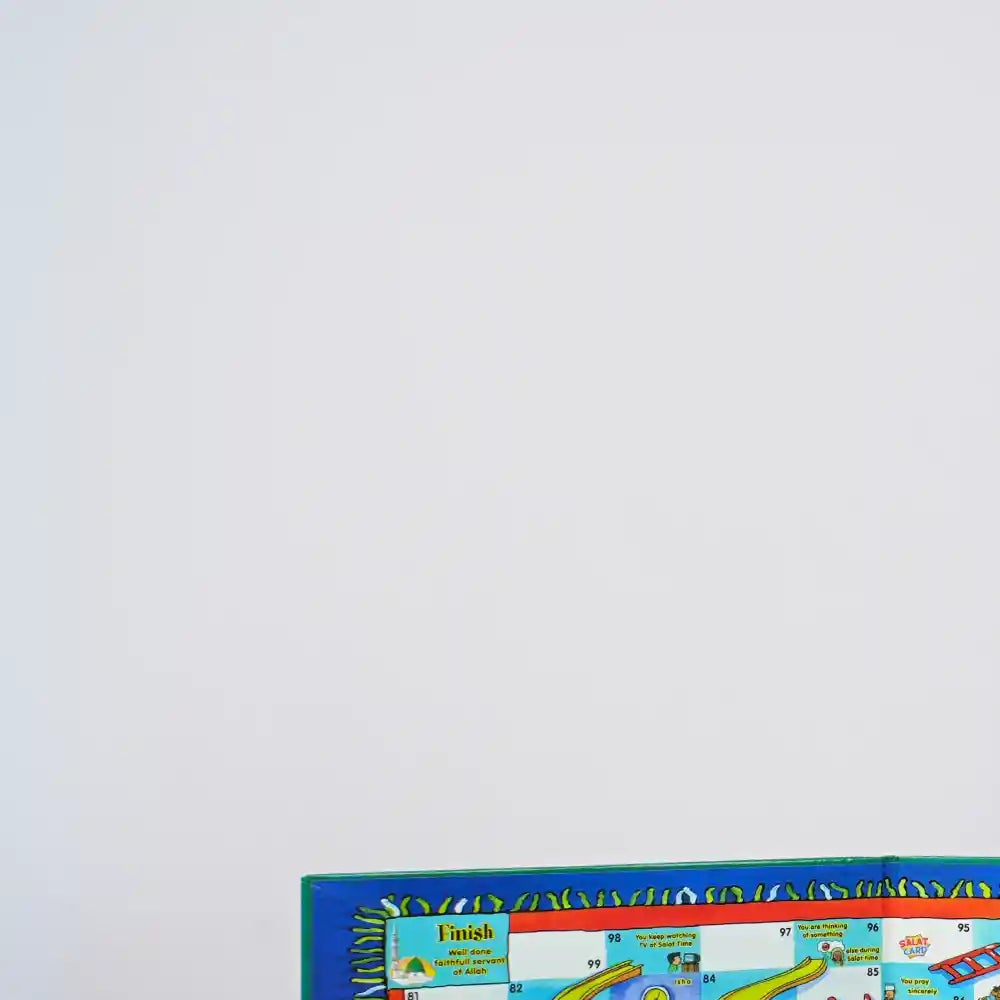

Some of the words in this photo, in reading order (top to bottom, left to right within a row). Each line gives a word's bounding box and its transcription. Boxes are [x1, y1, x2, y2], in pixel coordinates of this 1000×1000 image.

[779, 927, 792, 937] 97
[867, 922, 879, 932] 96
[957, 923, 970, 933] 95
[437, 923, 495, 942] Finish
[607, 933, 622, 943] 98
[448, 948, 467, 956] Well
[470, 948, 492, 956] done
[472, 957, 506, 966] servant
[587, 959, 601, 969] 99
[453, 968, 463, 976] of
[465, 967, 487, 975] Allah
[508, 983, 523, 994] 82
